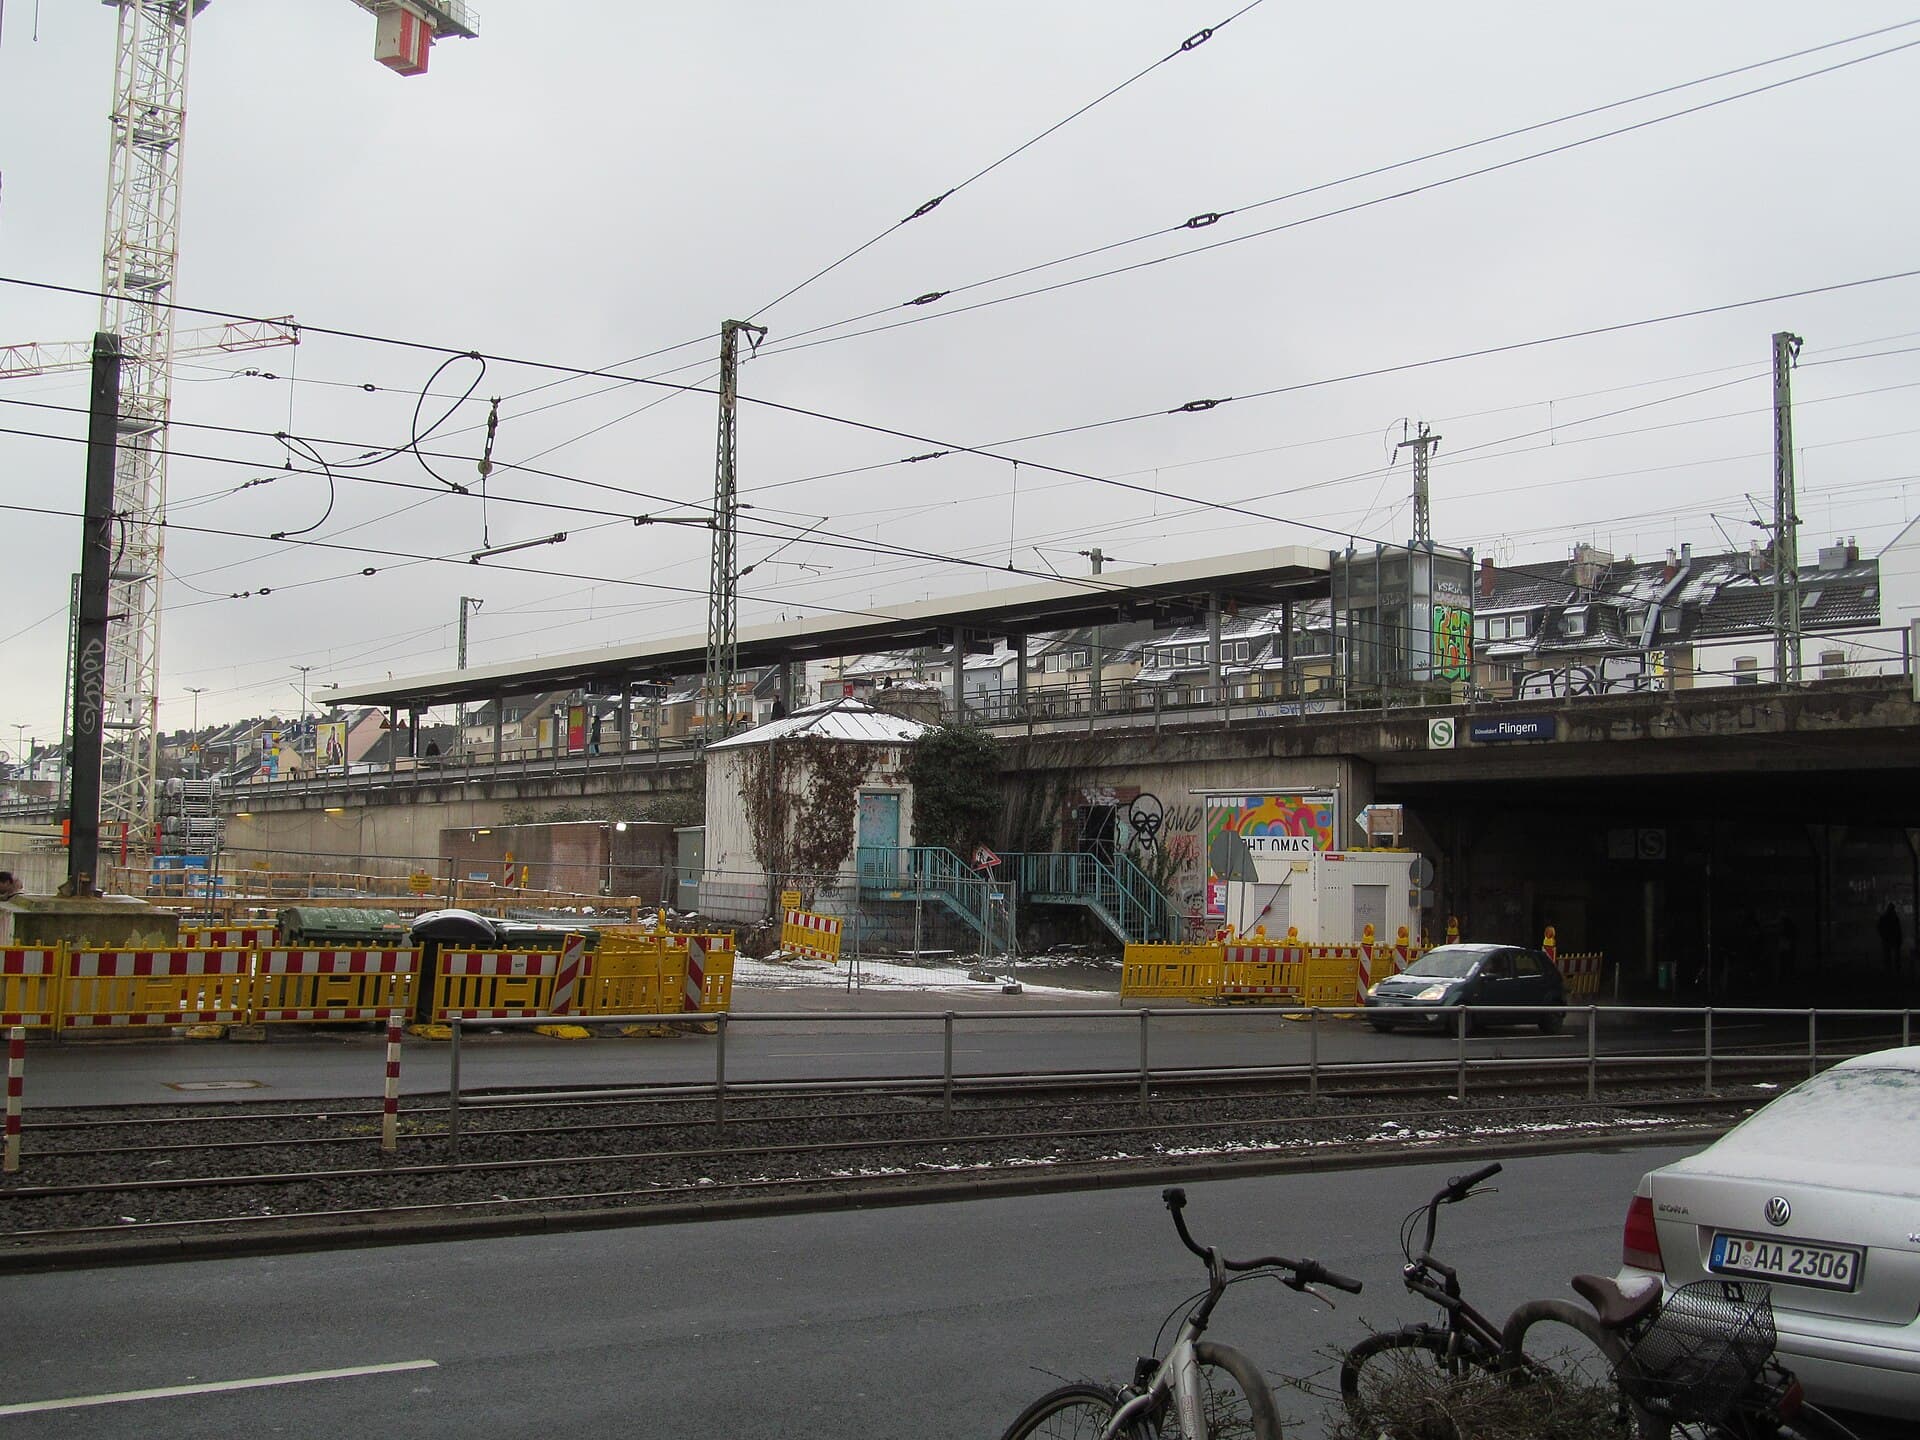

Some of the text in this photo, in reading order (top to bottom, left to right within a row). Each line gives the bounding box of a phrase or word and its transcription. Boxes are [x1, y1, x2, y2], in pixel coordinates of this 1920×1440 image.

[1499, 722, 1538, 735] Flingern
[1725, 1240, 1743, 1266] D
[1753, 1243, 1784, 1272] AA
[1787, 1249, 1849, 1280] 2306
